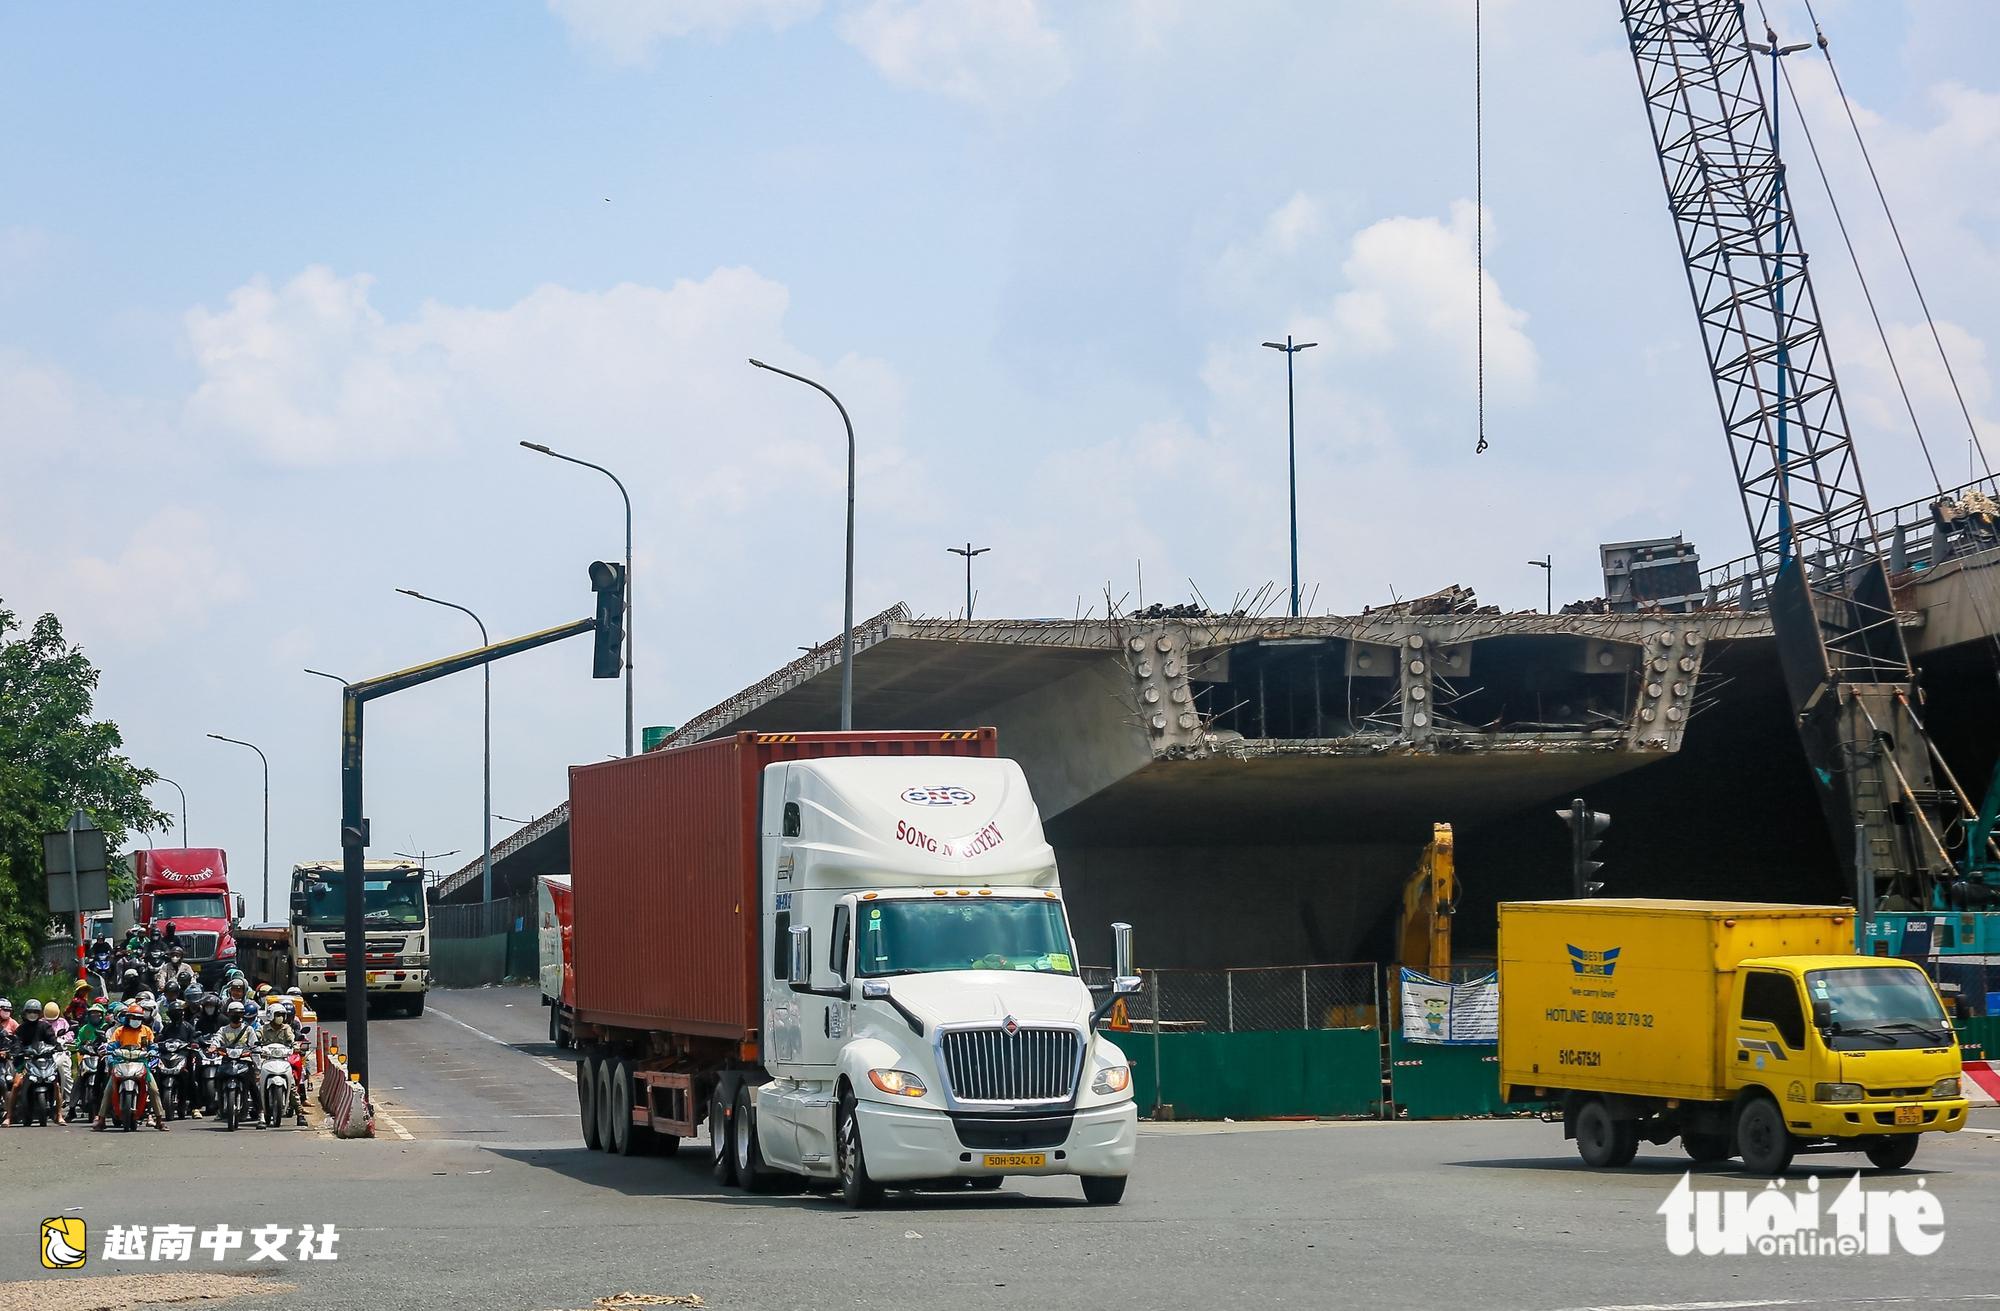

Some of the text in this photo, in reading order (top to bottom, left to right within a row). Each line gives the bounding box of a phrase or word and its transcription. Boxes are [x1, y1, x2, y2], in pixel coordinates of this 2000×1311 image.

[896, 819, 937, 853] SONG
[1583, 950, 1603, 961] BEST
[1592, 1010, 1613, 1025] 0908
[1642, 1014, 1654, 1028] 32
